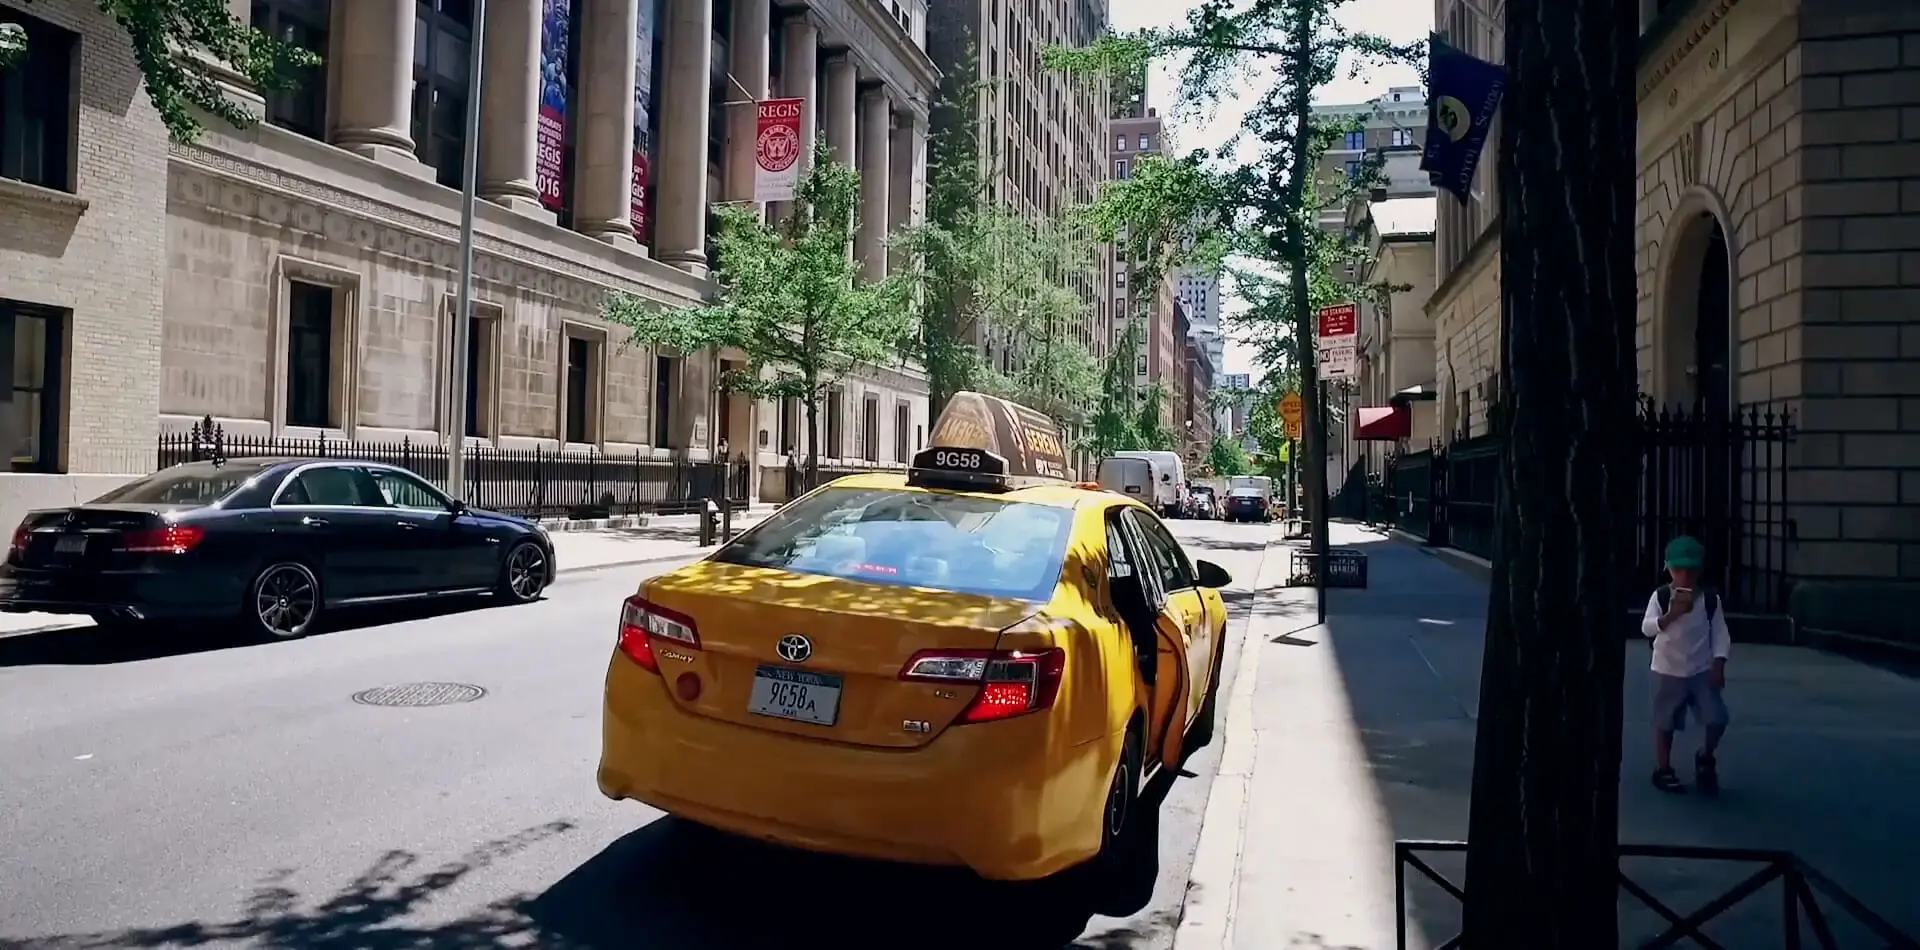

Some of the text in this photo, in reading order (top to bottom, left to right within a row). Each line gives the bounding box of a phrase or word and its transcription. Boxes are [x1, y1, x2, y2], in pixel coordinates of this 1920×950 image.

[759, 104, 800, 118] REGIS
[538, 143, 561, 165] EGIS
[538, 174, 560, 198] 016
[1320, 351, 1329, 361] NO
[1287, 423, 1297, 432] 15
[1024, 427, 1063, 457] SERENA
[936, 451, 980, 468] 9G58
